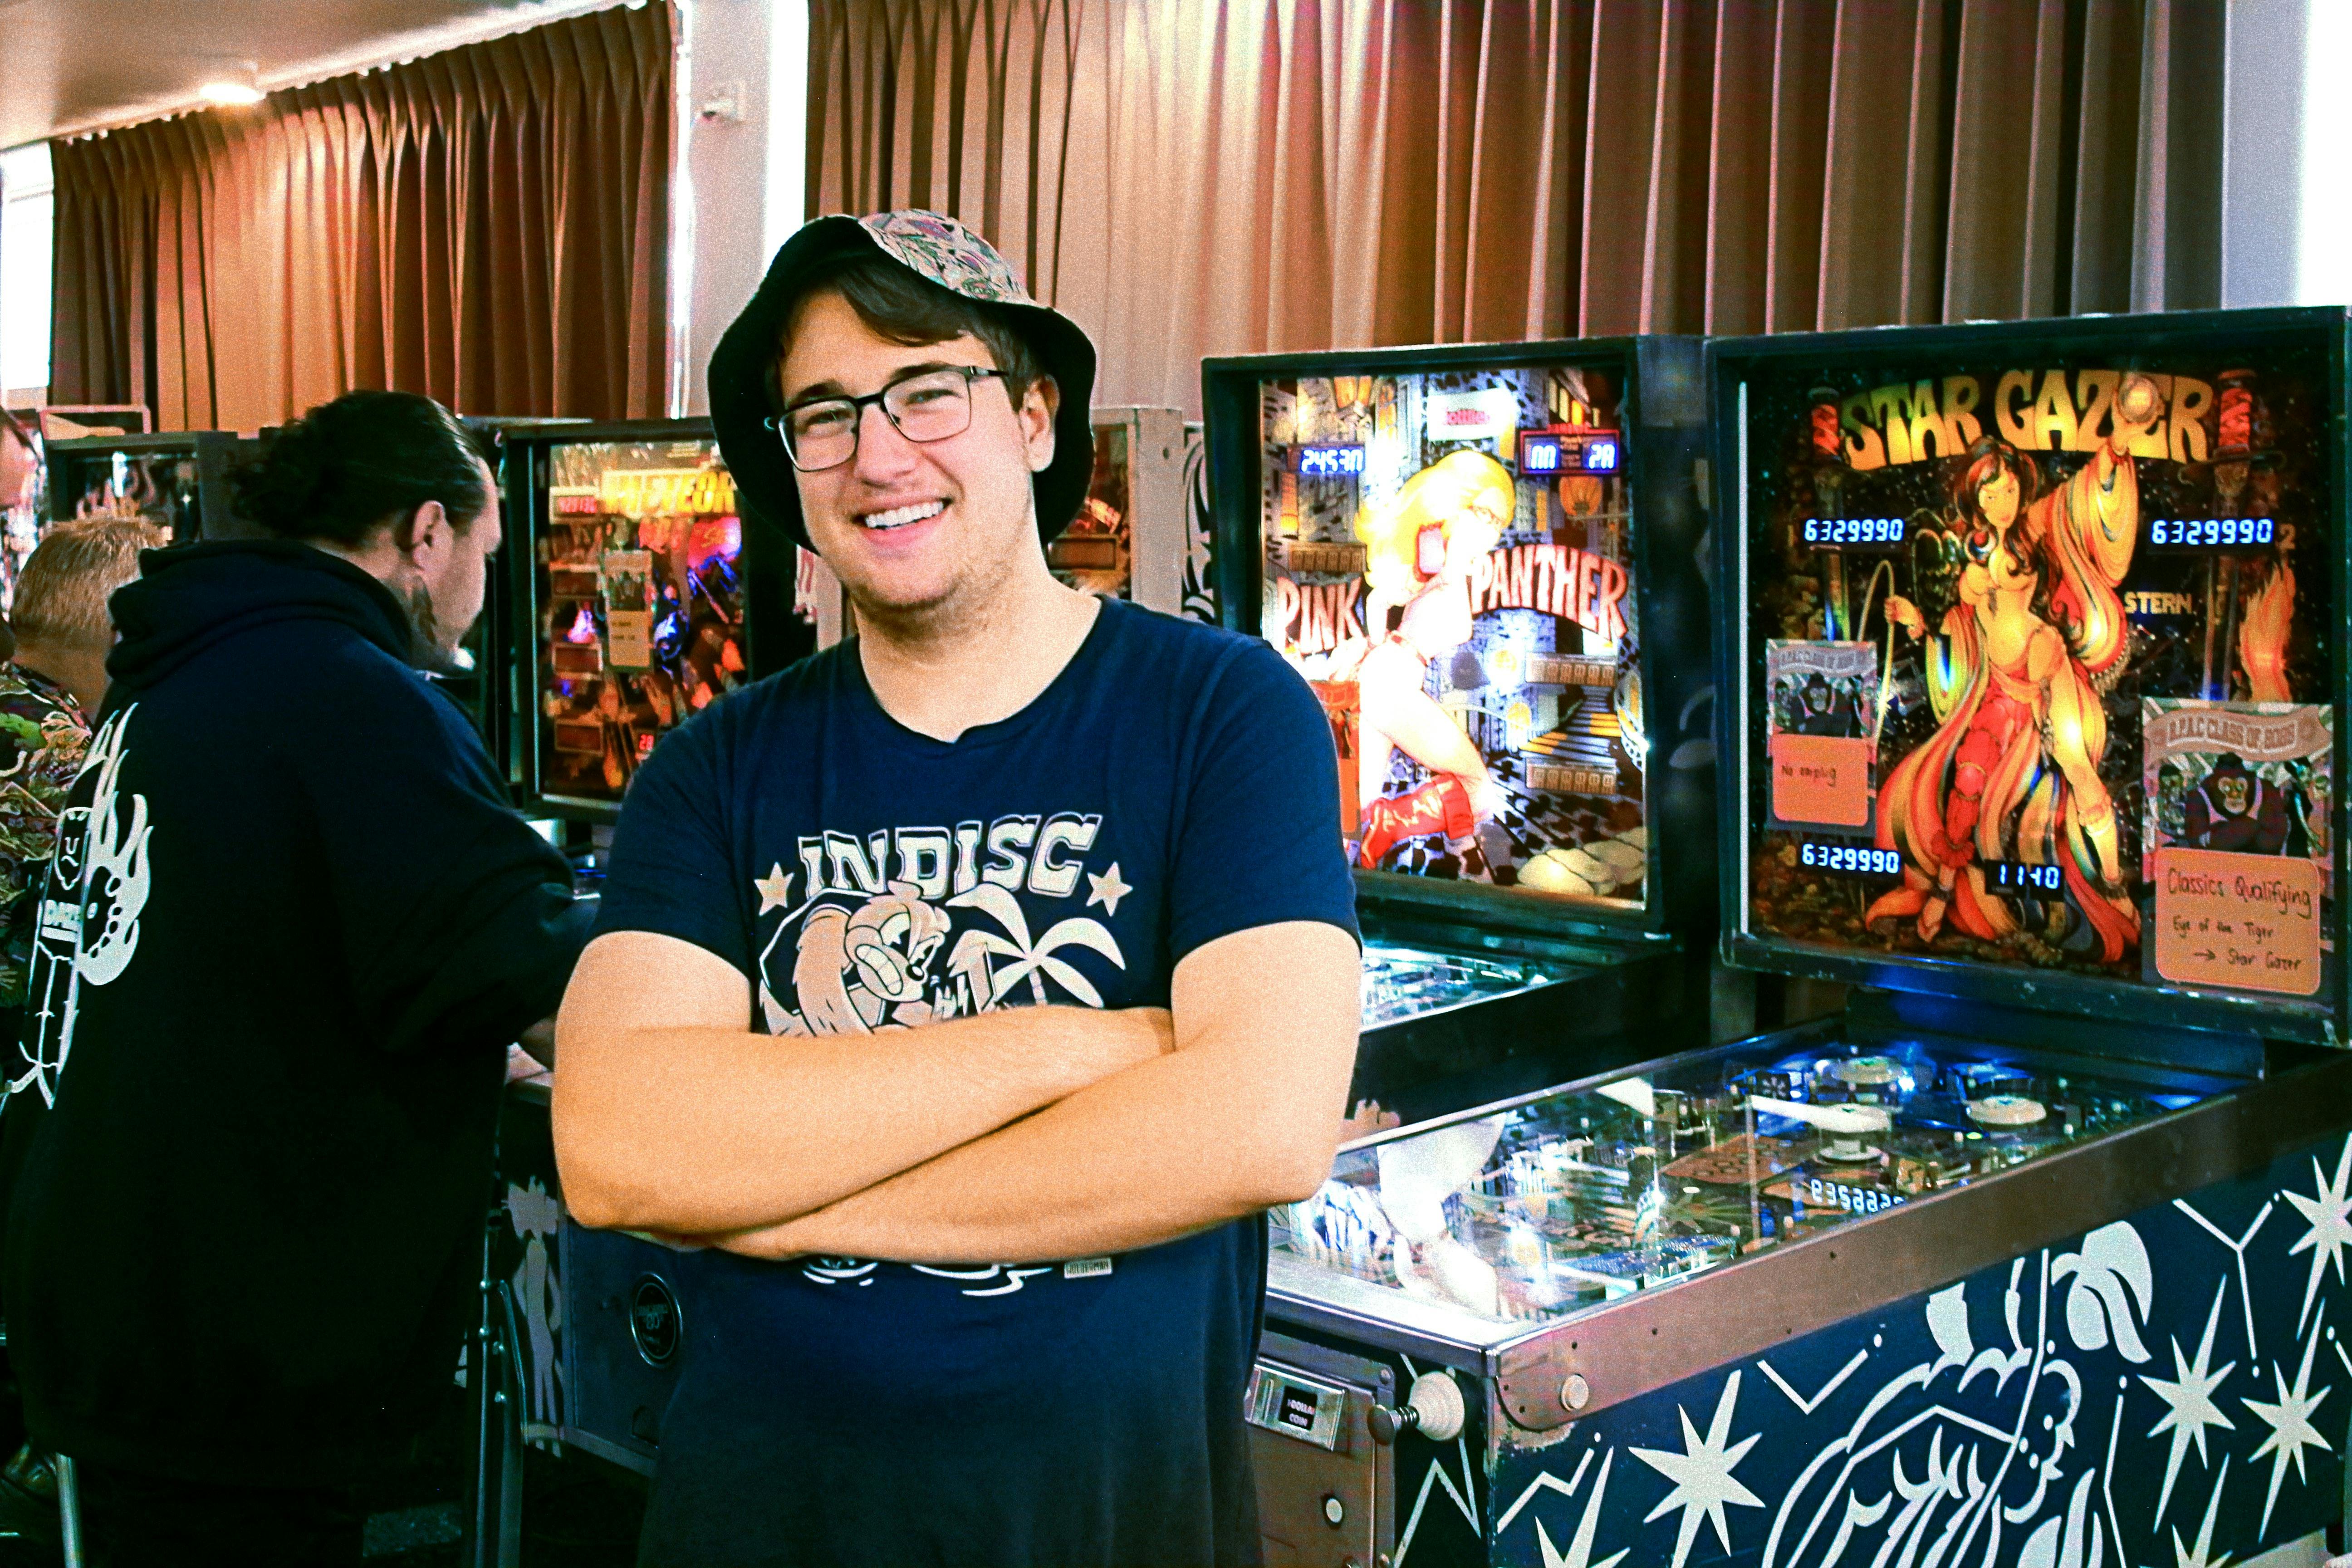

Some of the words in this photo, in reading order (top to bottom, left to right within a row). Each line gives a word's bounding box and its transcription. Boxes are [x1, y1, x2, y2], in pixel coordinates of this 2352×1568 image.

[1842, 376, 1982, 470] STAR
[1995, 370, 2214, 464] GAZER
[1804, 519, 1903, 542] 6329990
[2151, 519, 2273, 544] 6329990
[1471, 544, 1628, 640] PANTHER
[2124, 592, 2193, 615] STERN
[1276, 576, 1366, 652] PINK
[798, 811, 1102, 900] INDISC
[1802, 843, 1900, 873] 6329990
[1999, 864, 2059, 889] 1140
[2167, 867, 2225, 897] Classics
[2235, 876, 2312, 920] Qualifying
[2173, 915, 2190, 938] Eye
[2199, 917, 2210, 931] of
[2217, 919, 2234, 934] the
[2244, 921, 2274, 945] Tiger
[2227, 947, 2256, 965] Star
[2266, 951, 2302, 971] Gazer
[1289, 1413, 1308, 1427] COIN
